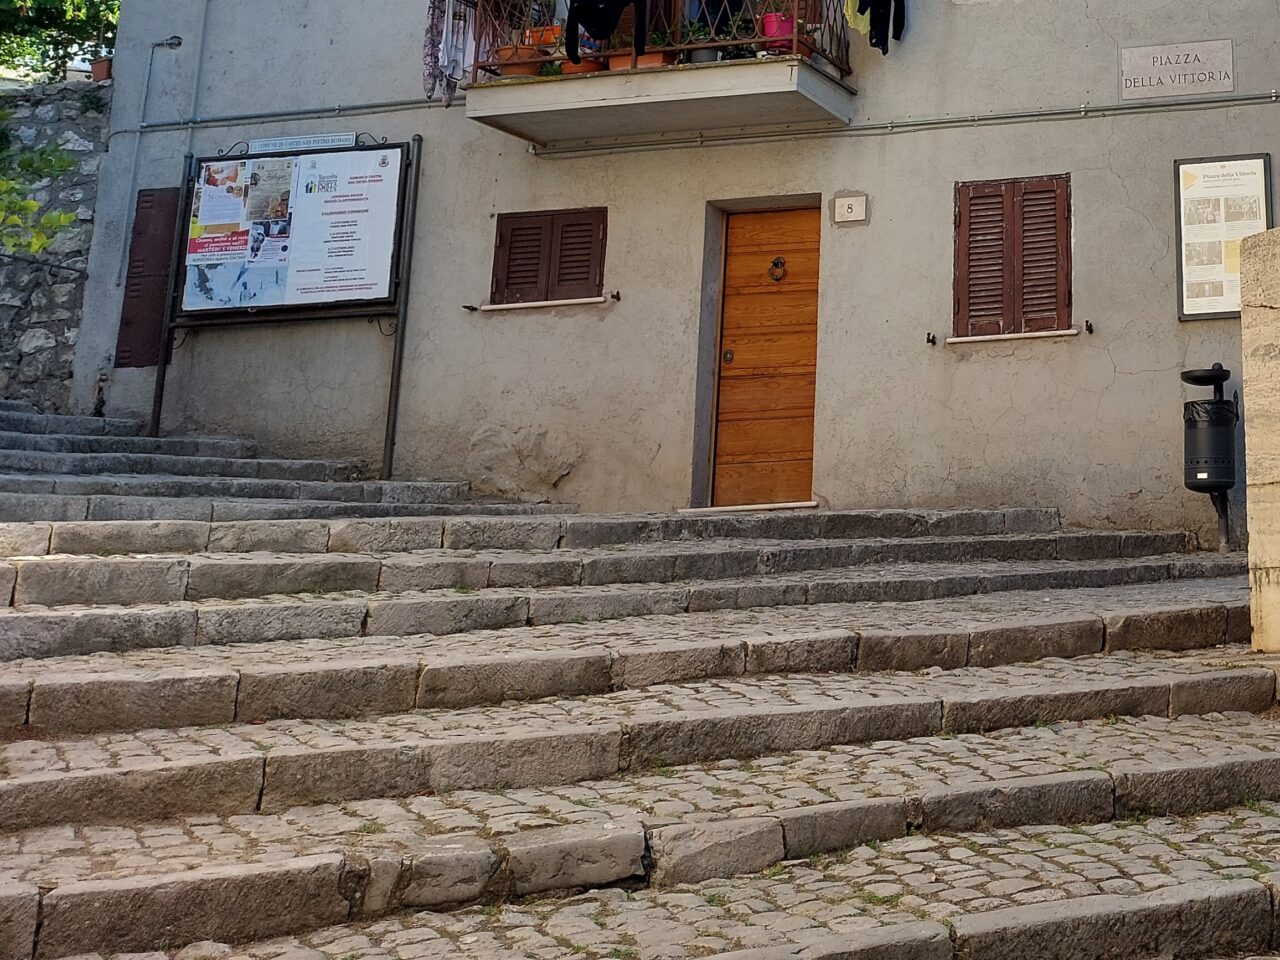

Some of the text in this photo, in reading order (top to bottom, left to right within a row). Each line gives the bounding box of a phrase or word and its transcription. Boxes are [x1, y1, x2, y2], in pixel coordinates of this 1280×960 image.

[1152, 53, 1201, 66] PIAZZA
[1124, 70, 1231, 89] DELLA VITTORIA
[302, 139, 311, 147] SAN
[312, 138, 329, 146] PIETRO
[330, 136, 352, 145] ROMANO
[846, 203, 854, 214] 8
